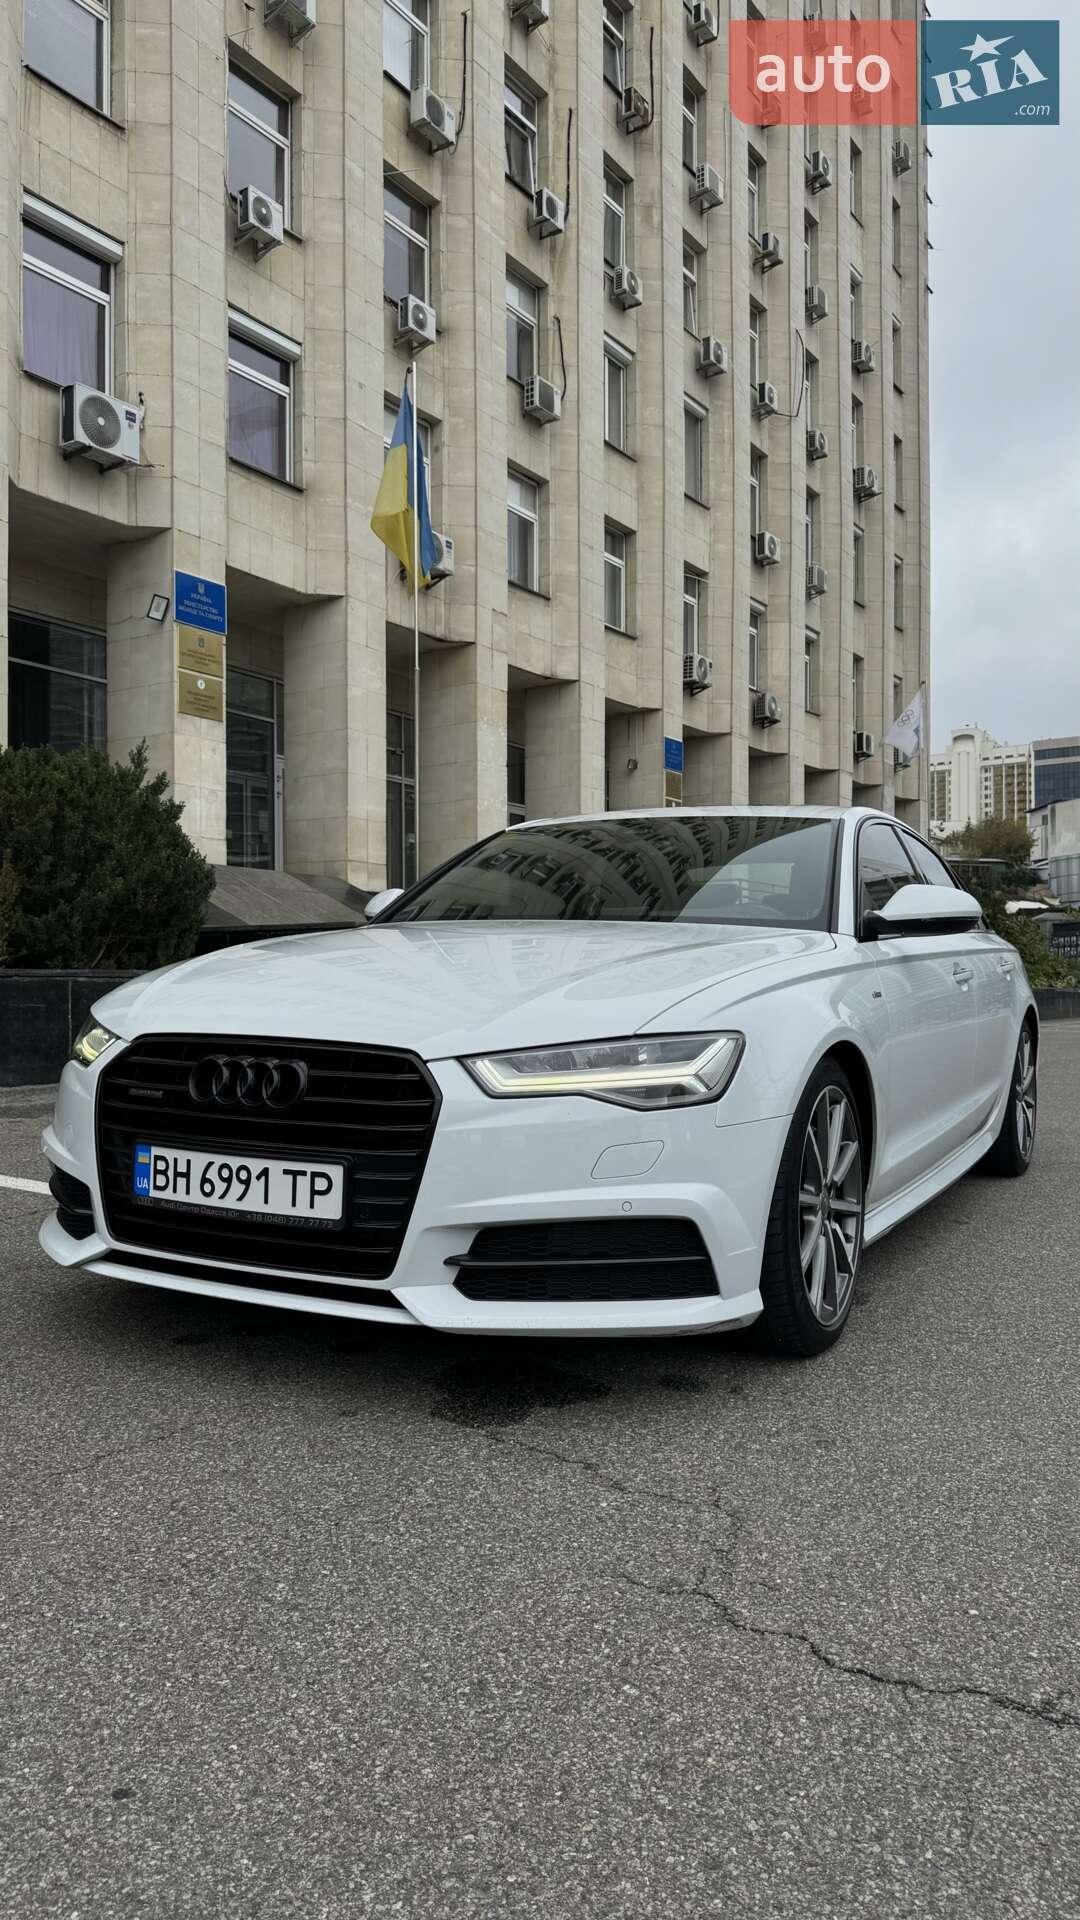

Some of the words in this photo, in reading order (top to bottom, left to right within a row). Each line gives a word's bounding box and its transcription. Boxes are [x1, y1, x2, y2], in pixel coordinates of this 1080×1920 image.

[136, 1176, 149, 1189] UA
[153, 1154, 191, 1195] BH
[200, 1160, 270, 1205] 6991
[282, 1168, 334, 1209] TP
